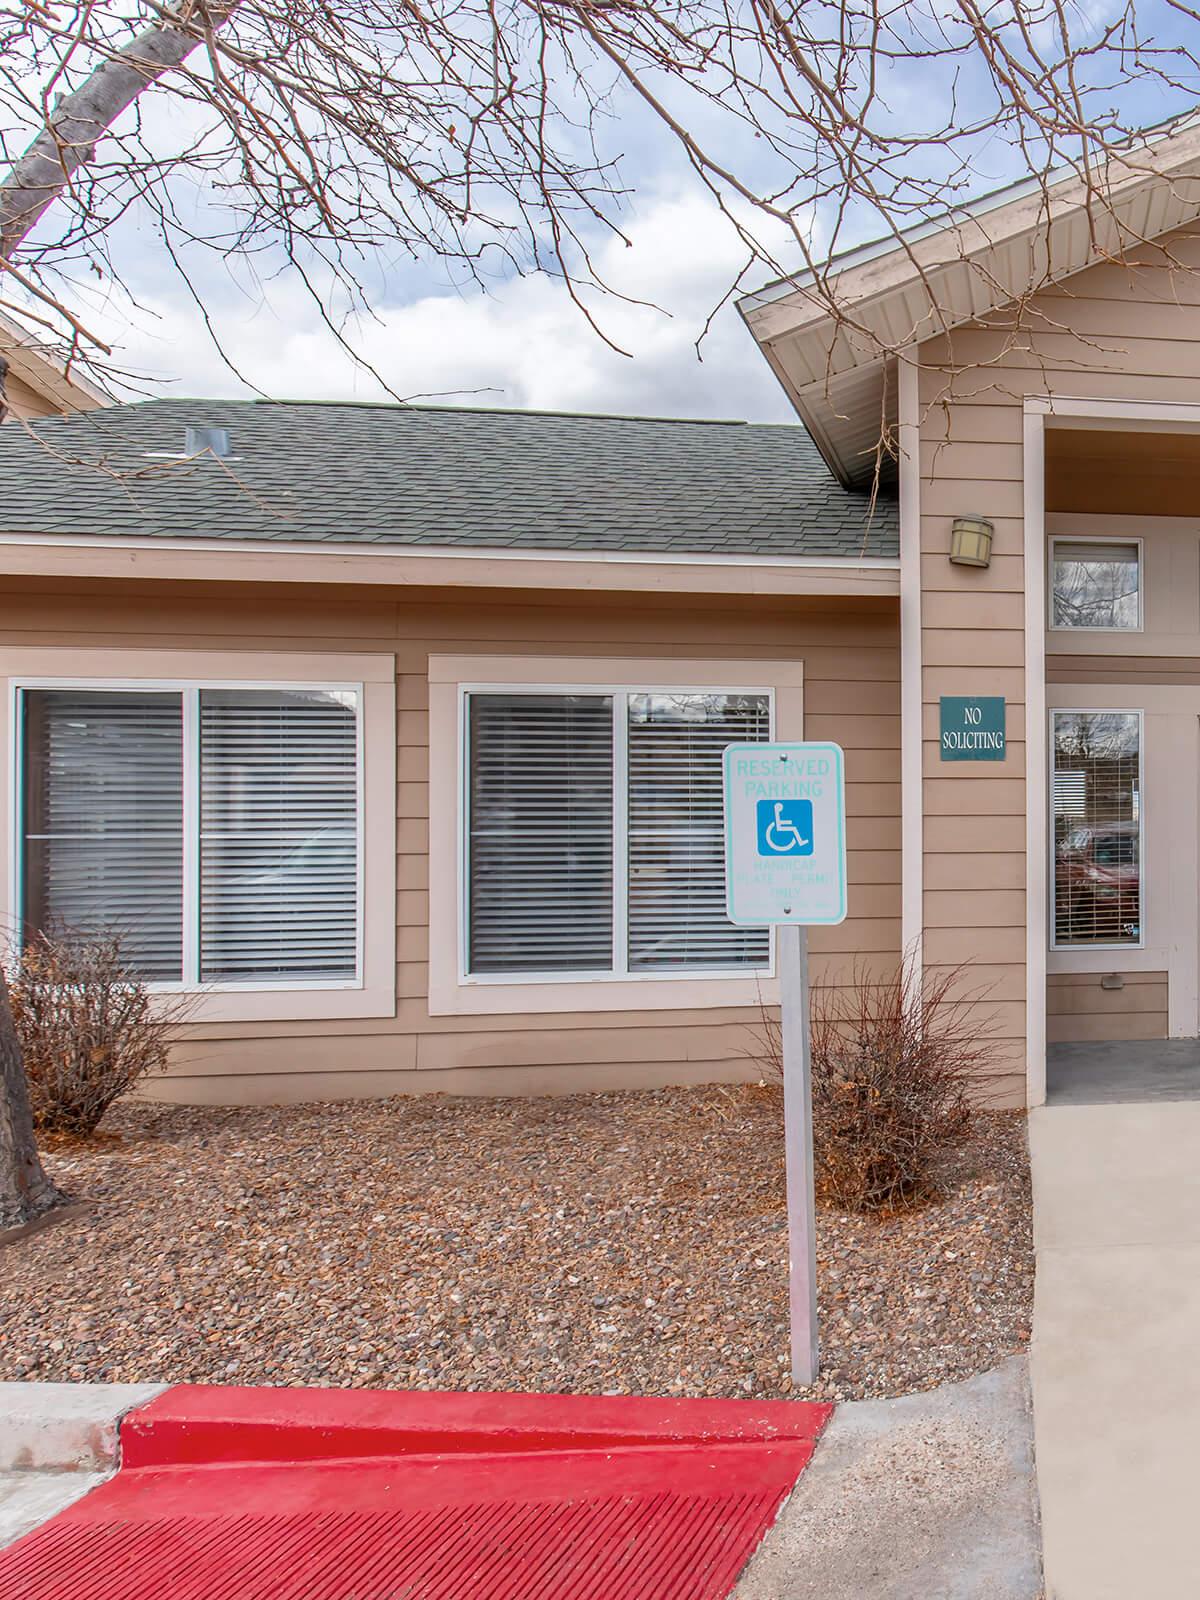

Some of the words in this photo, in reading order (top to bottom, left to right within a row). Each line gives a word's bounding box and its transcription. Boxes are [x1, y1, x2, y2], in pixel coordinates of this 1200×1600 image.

[964, 707, 982, 725] NO
[943, 732, 1003, 749] SOLICITING
[737, 759, 830, 776] RESERVED
[744, 780, 823, 798] PARKING
